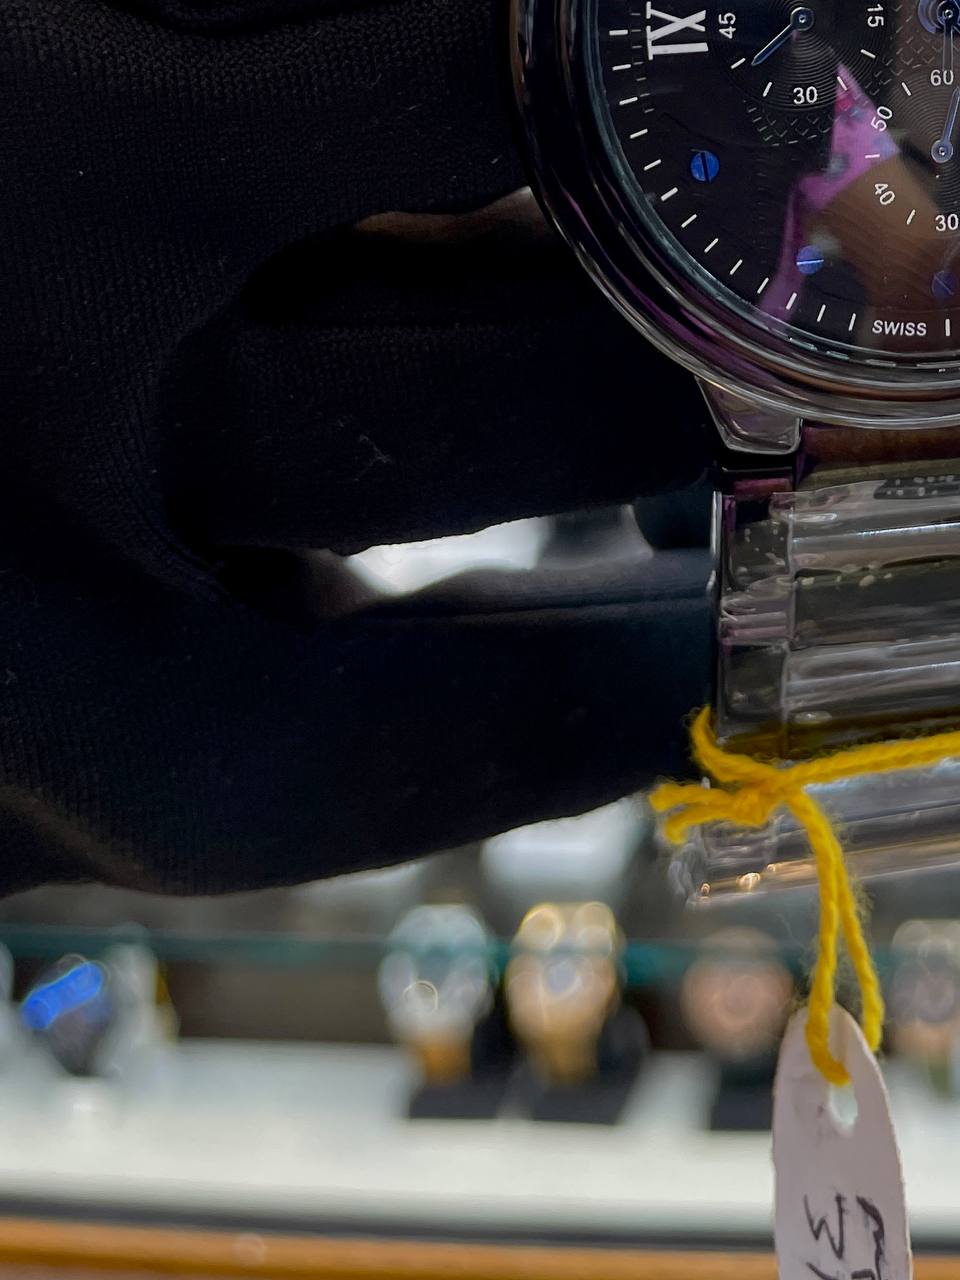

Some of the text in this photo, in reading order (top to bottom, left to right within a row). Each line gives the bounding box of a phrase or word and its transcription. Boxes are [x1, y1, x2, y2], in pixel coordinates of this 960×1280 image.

[718, 12, 737, 39] 45
[867, 3, 885, 28] 15
[646, 1, 709, 60] IX
[930, 69, 954, 87] 60
[793, 86, 818, 104] 30
[870, 106, 893, 132] 50
[874, 183, 896, 206] 40
[935, 213, 959, 232] 30
[871, 319, 927, 337] SWISS
